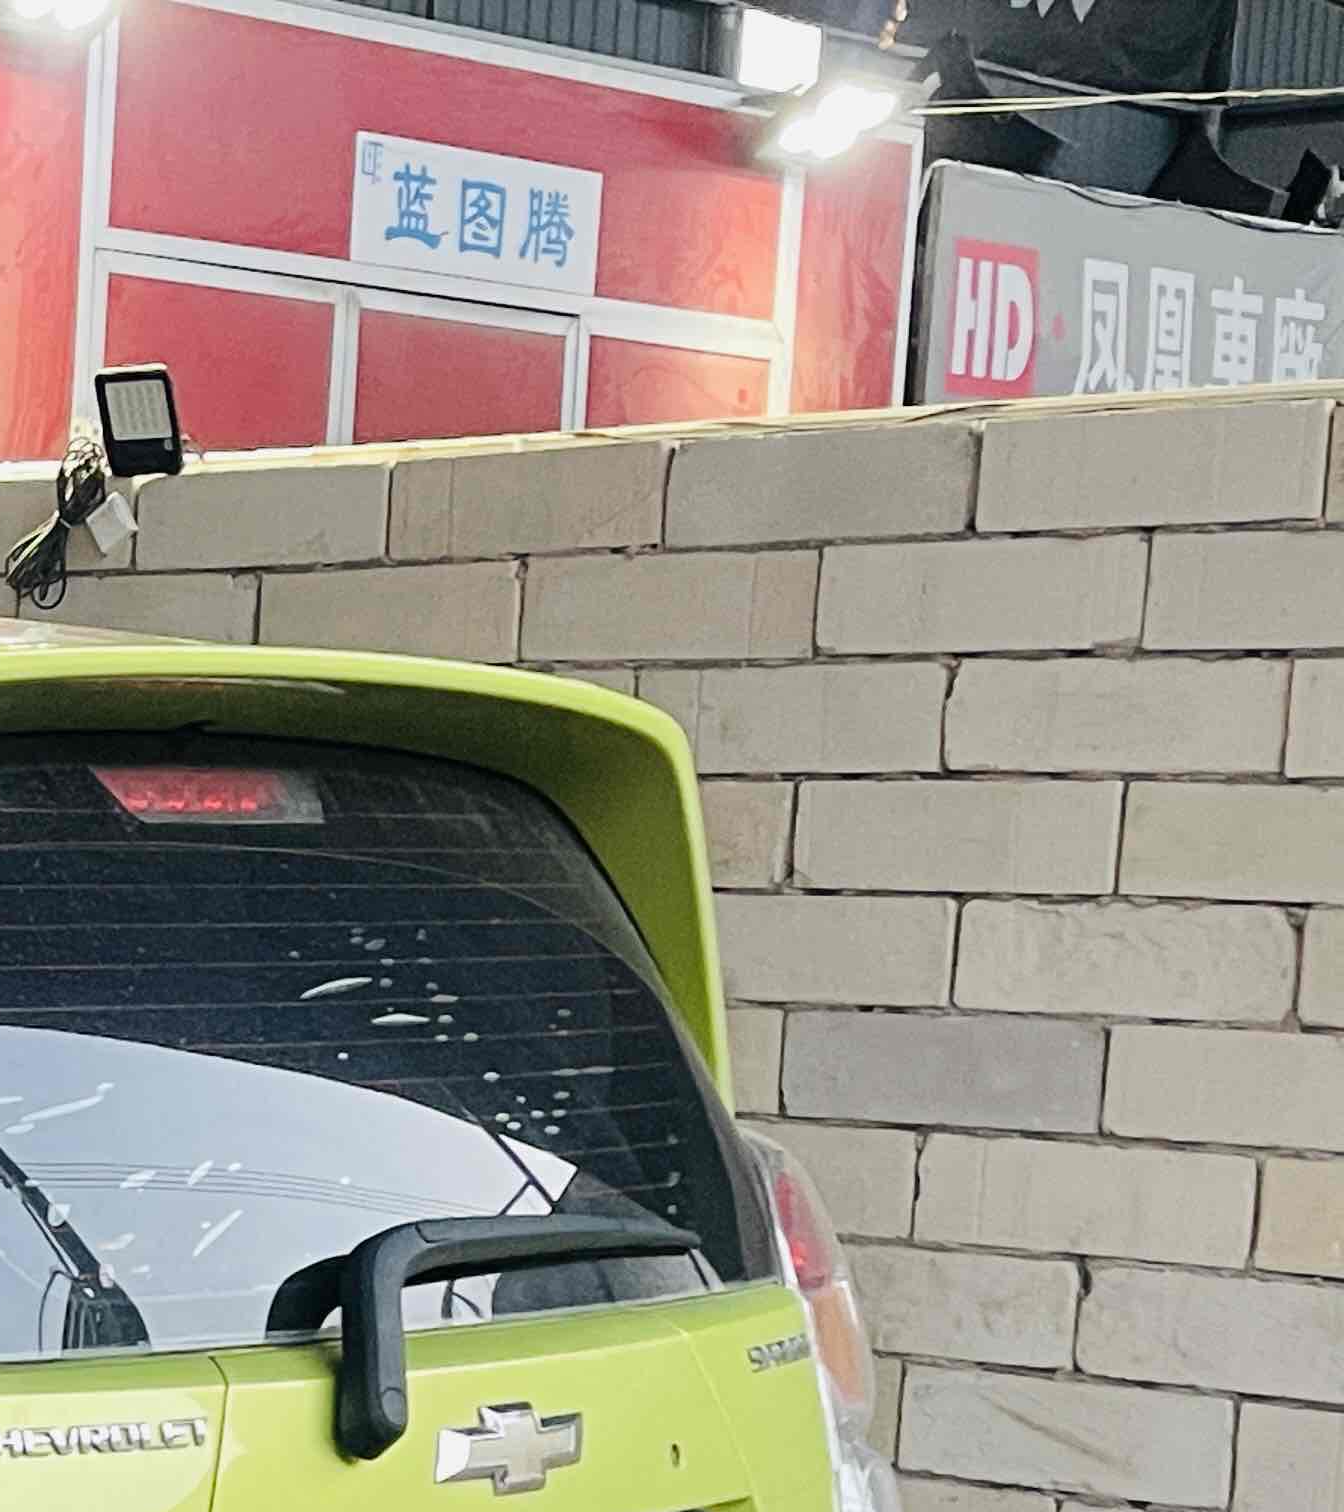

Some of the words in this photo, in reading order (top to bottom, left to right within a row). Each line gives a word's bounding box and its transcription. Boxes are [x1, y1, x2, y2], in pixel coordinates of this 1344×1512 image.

[385, 163, 576, 267] 蓝图腾
[950, 256, 1035, 382] HD
